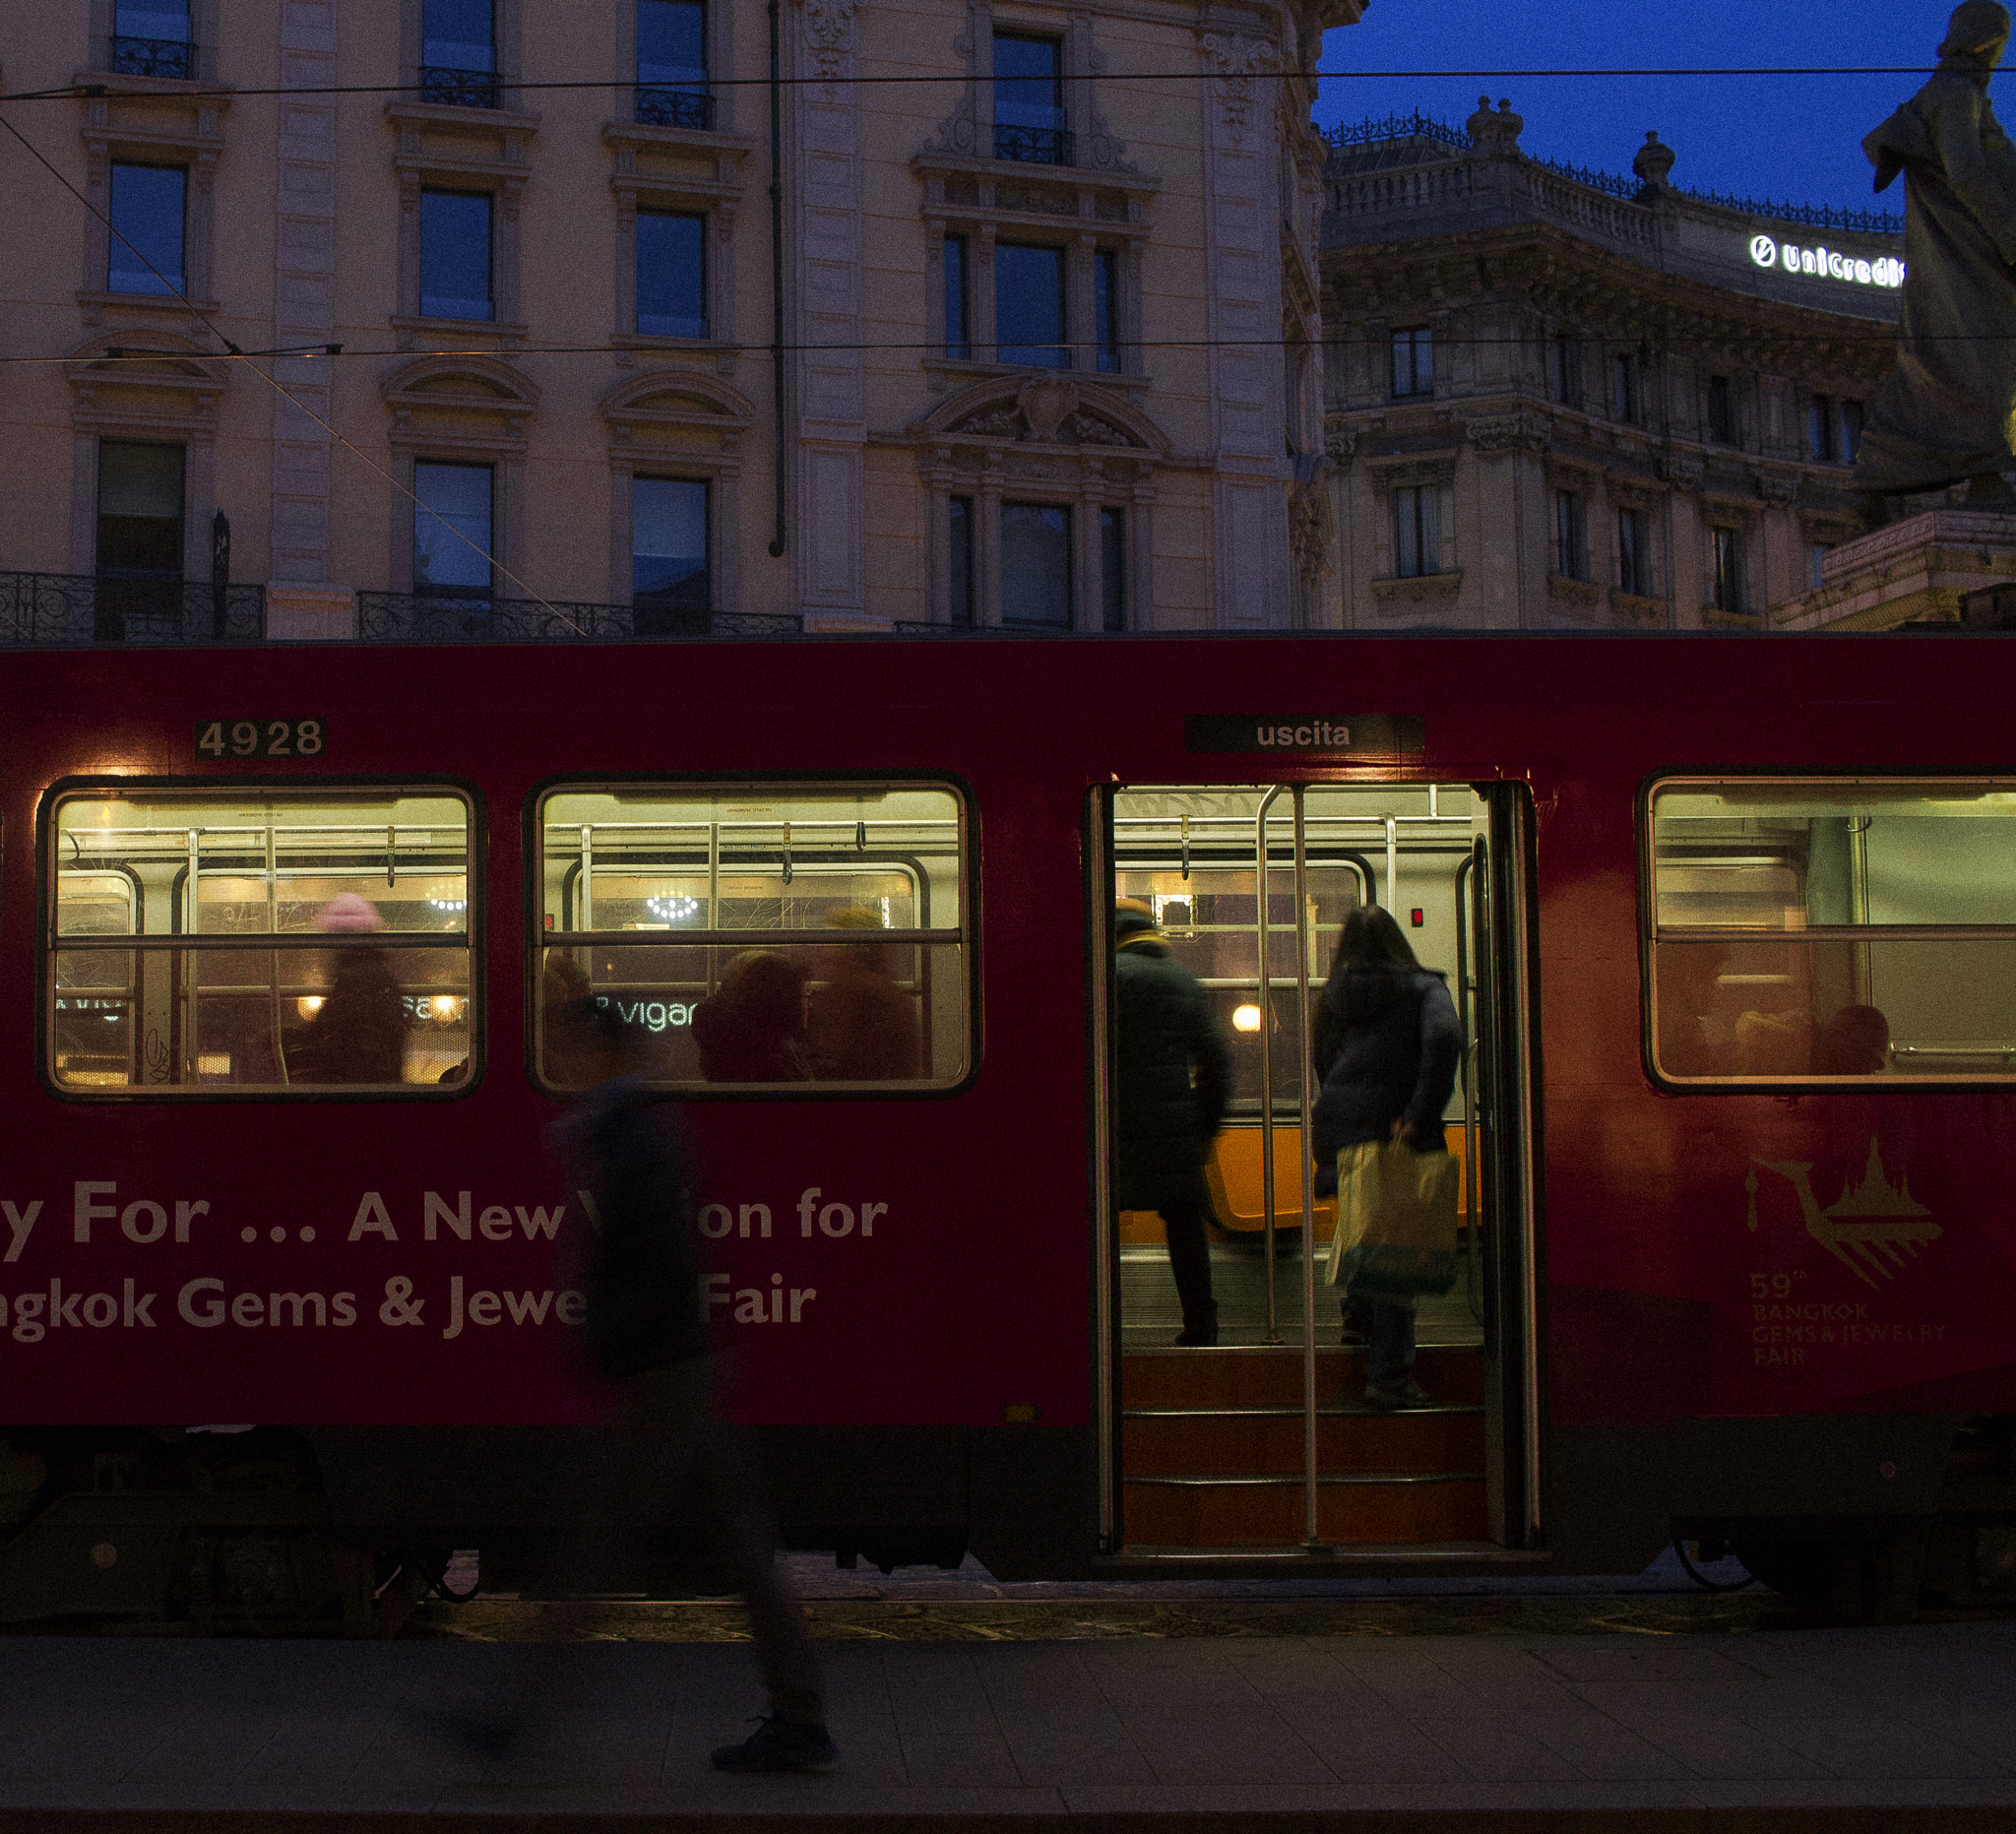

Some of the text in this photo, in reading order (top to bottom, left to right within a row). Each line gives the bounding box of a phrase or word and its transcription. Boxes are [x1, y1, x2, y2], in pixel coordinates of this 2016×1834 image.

[199, 721, 323, 756] 4928
[1257, 721, 1350, 745] uscita
[74, 1180, 211, 1243] For
[347, 1192, 399, 1241] A
[423, 1190, 567, 1241] New
[796, 1187, 888, 1237] for
[0, 1277, 158, 1343] gkok
[177, 1277, 357, 1328] Gems
[378, 1275, 425, 1326] &
[697, 1273, 817, 1323] Fair
[1753, 1302, 1869, 1321] BANGKOK
[1752, 1324, 1946, 1346] GEMS & JEWELRY
[1754, 1348, 1804, 1365] FAIR
